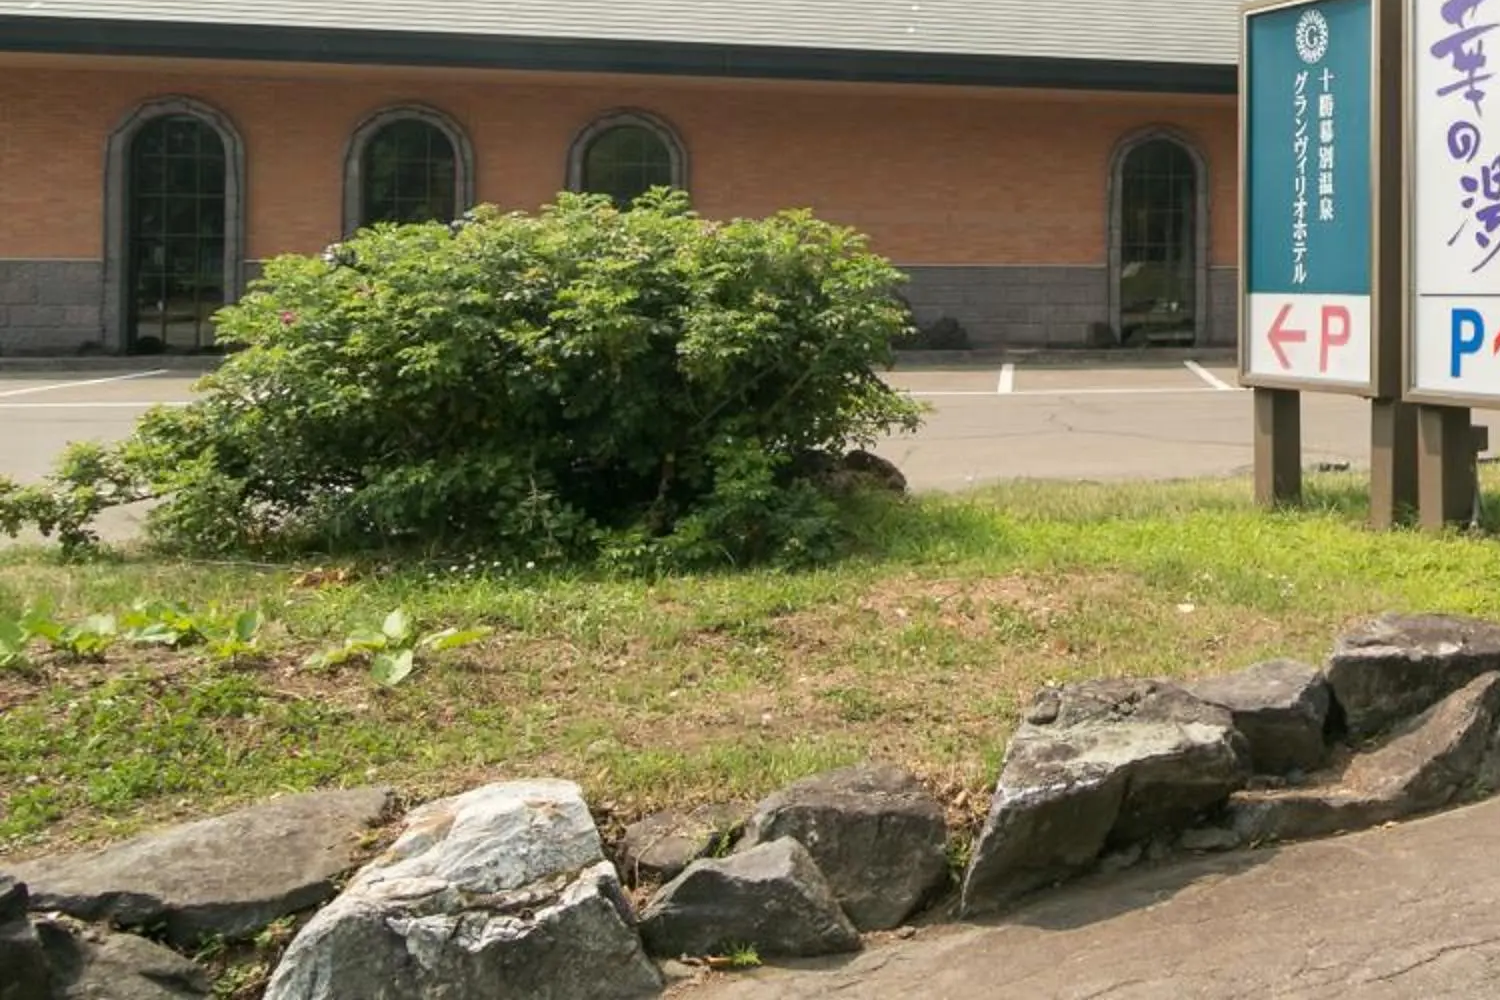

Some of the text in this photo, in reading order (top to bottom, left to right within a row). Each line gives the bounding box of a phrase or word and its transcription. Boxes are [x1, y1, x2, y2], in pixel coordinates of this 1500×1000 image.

[1292, 70, 1309, 284] グランヴィリオホテル
[1320, 305, 1351, 372] P
[1450, 307, 1485, 377] P
